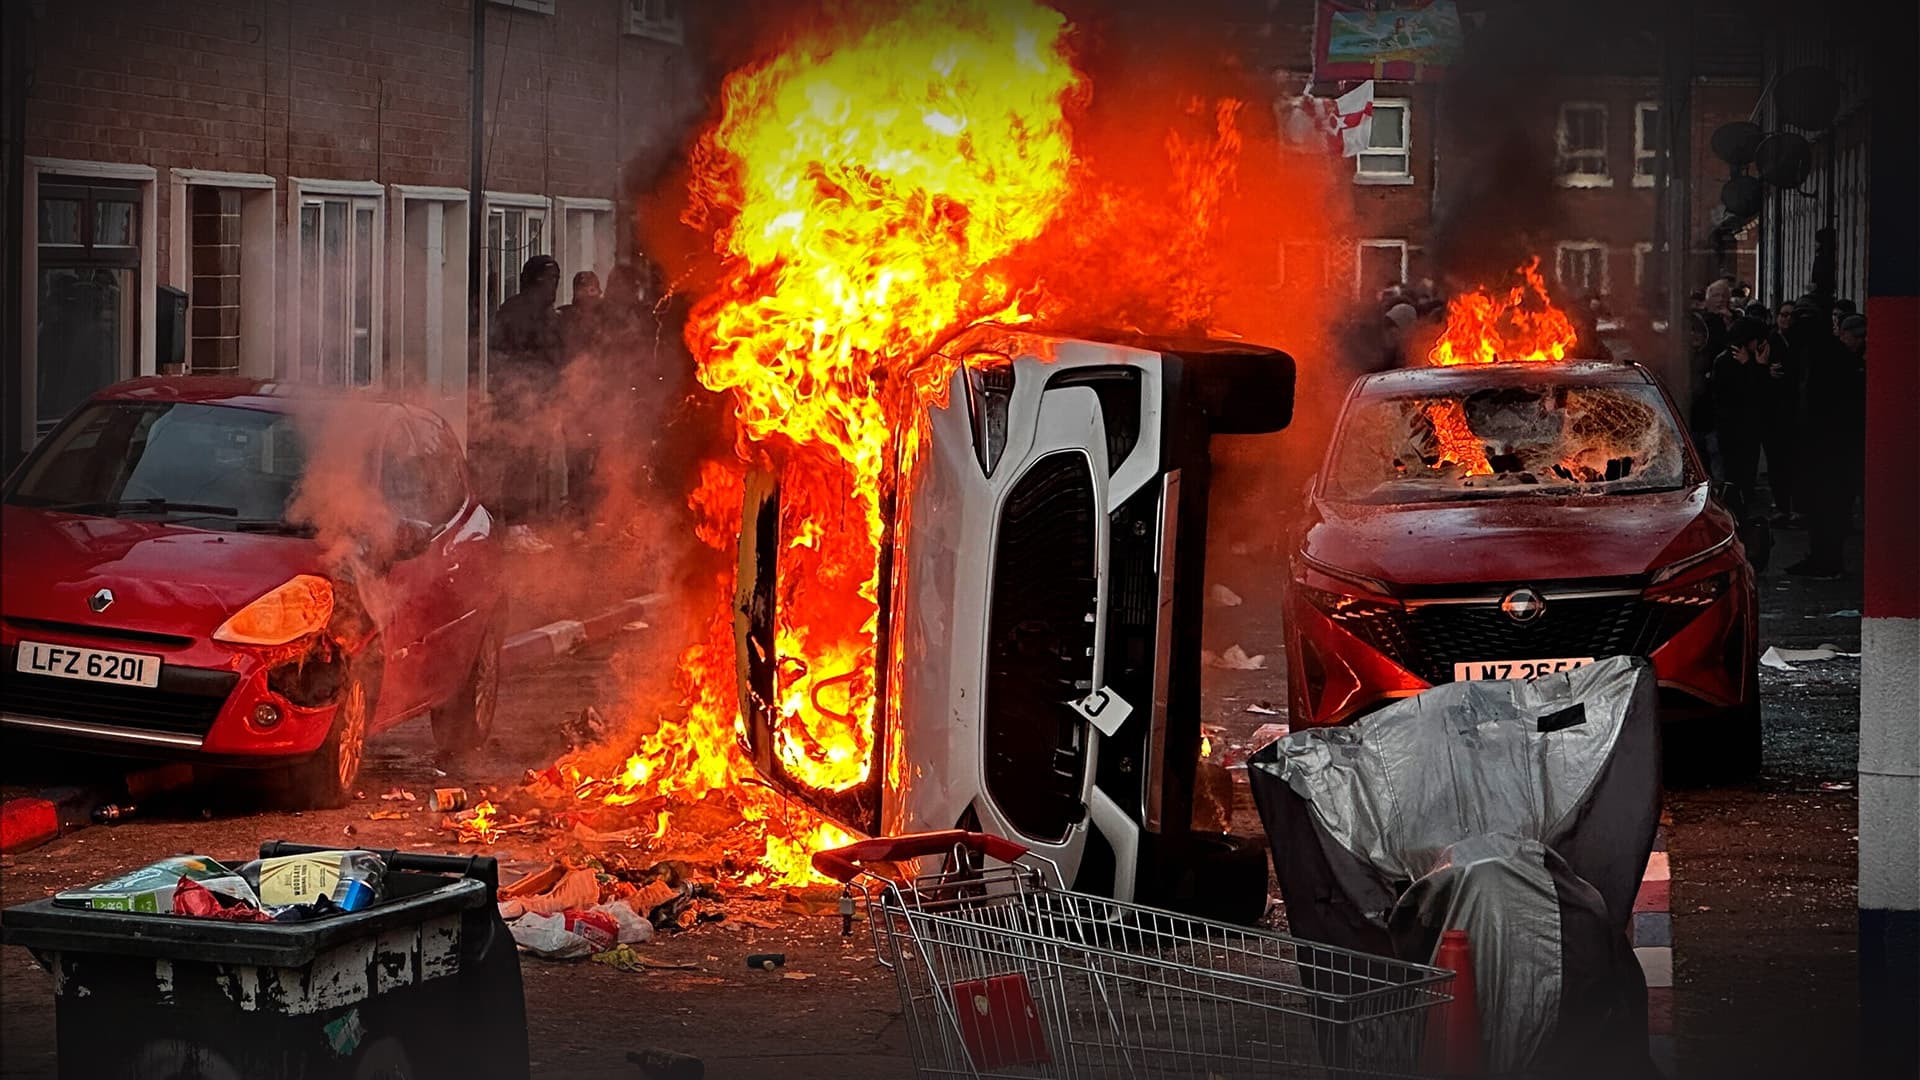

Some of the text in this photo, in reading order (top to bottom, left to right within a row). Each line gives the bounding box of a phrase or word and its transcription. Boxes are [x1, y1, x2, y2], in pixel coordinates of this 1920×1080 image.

[31, 646, 144, 682] LFZ 6201
[293, 864, 301, 896] WOODGATE
